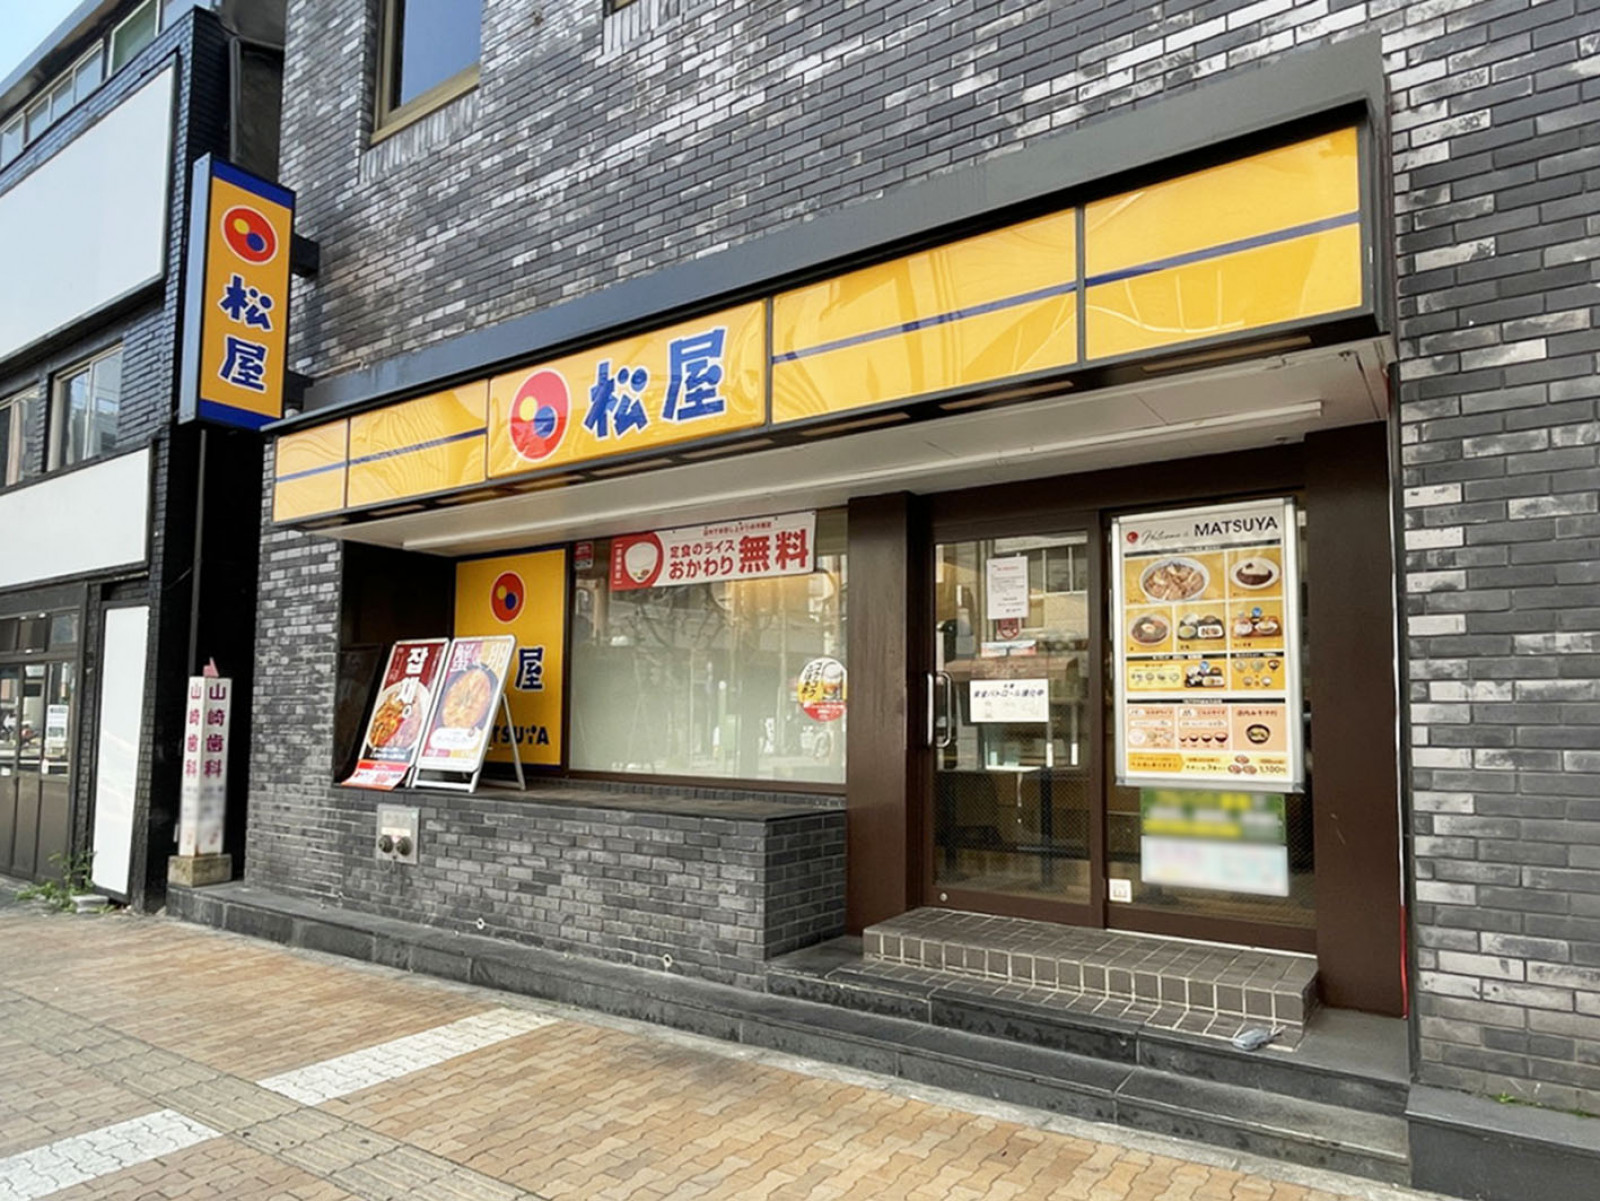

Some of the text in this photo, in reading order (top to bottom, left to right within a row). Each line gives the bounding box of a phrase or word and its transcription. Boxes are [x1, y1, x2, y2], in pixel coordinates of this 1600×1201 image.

[220, 276, 274, 393] 松屋
[583, 327, 727, 440] 松屋
[669, 539, 736, 559] 定食のライス
[1195, 516, 1278, 538] MATSUYA
[669, 556, 734, 580] おかわり
[738, 528, 809, 573] 無料
[203, 683, 226, 778] 山崎歯科
